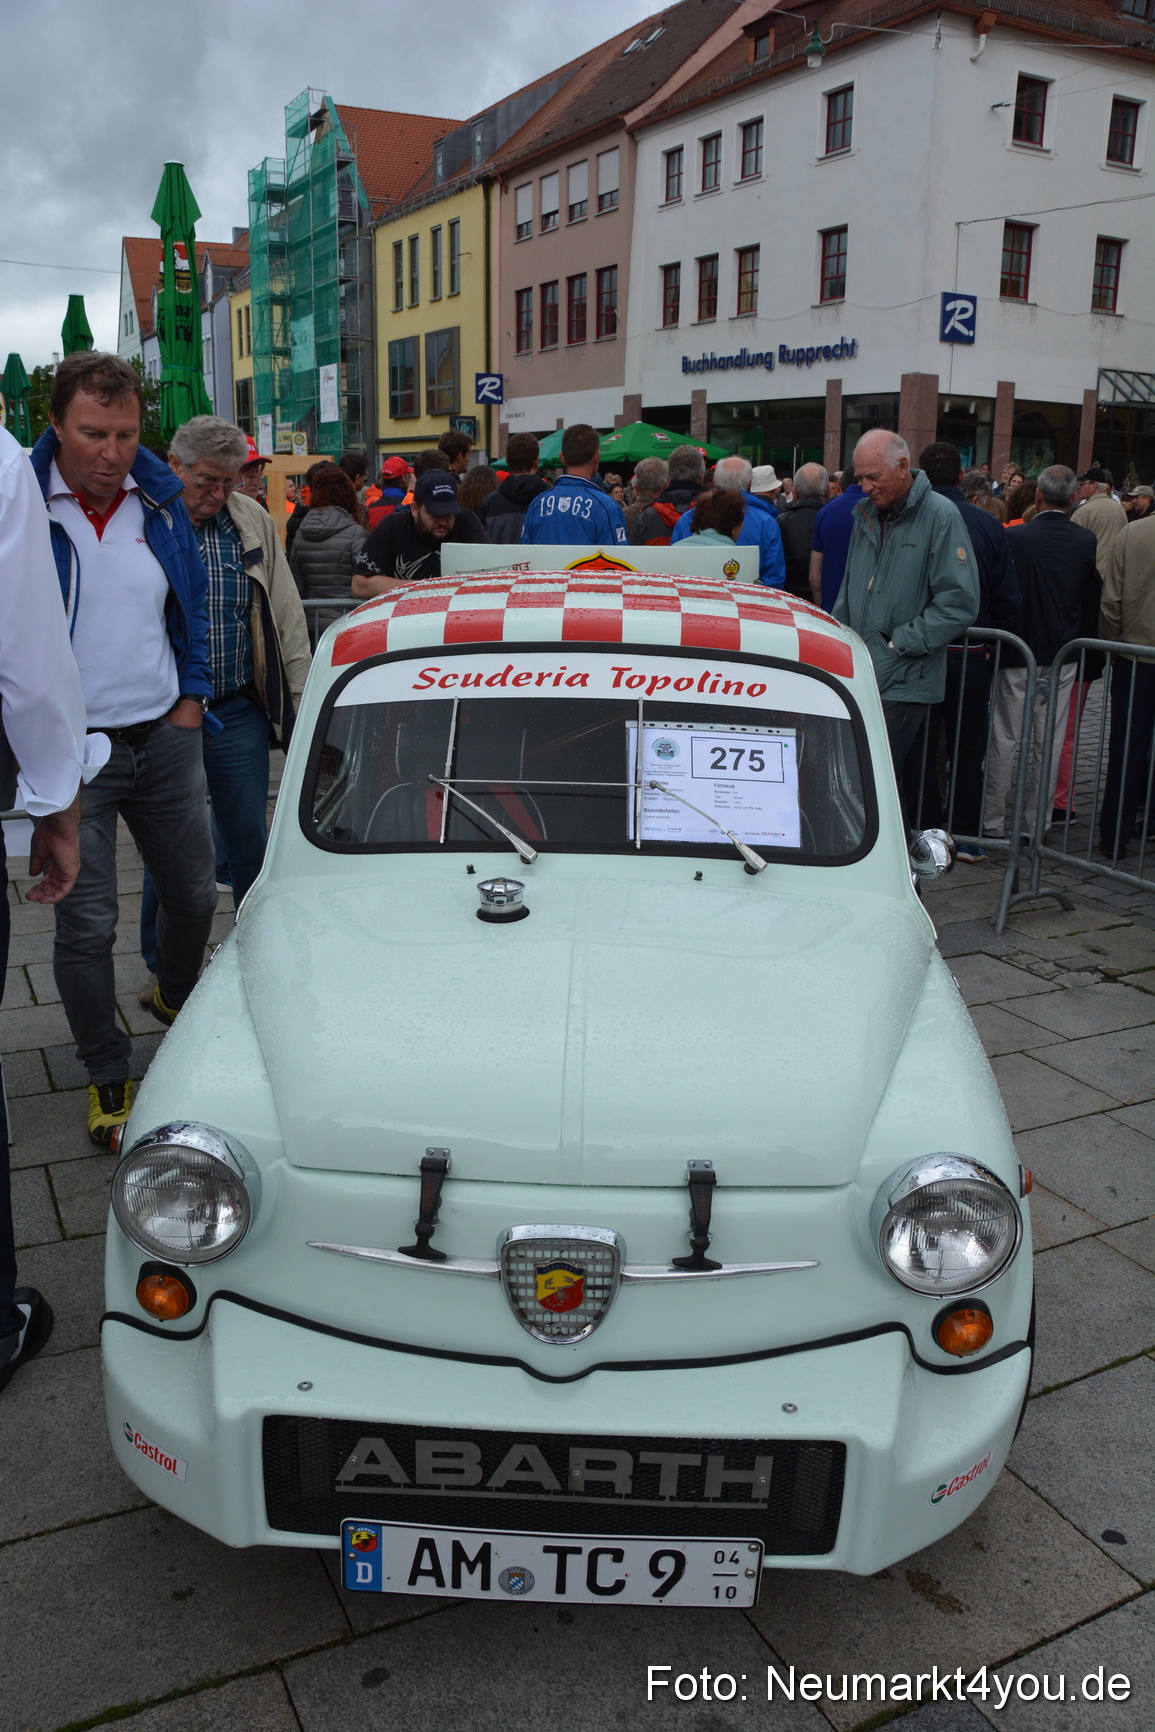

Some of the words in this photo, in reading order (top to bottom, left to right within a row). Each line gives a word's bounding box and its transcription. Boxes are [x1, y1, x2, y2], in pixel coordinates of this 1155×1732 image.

[682, 346, 774, 374] Buchhandlung
[778, 336, 857, 368] Rupprecht
[540, 495, 555, 517] 19
[572, 495, 593, 518] 63
[412, 664, 590, 691] Scuderia
[609, 667, 768, 697] Topolino
[709, 746, 766, 772] 275
[134, 1432, 178, 1476] Castrol
[335, 1436, 774, 1500] ABARTH
[946, 1450, 993, 1497] Castrol
[355, 1561, 373, 1584] D
[407, 1536, 492, 1592] AM
[542, 1544, 626, 1597] TC
[648, 1548, 686, 1598] 9
[714, 1550, 740, 1565] 04
[713, 1585, 737, 1600] 10
